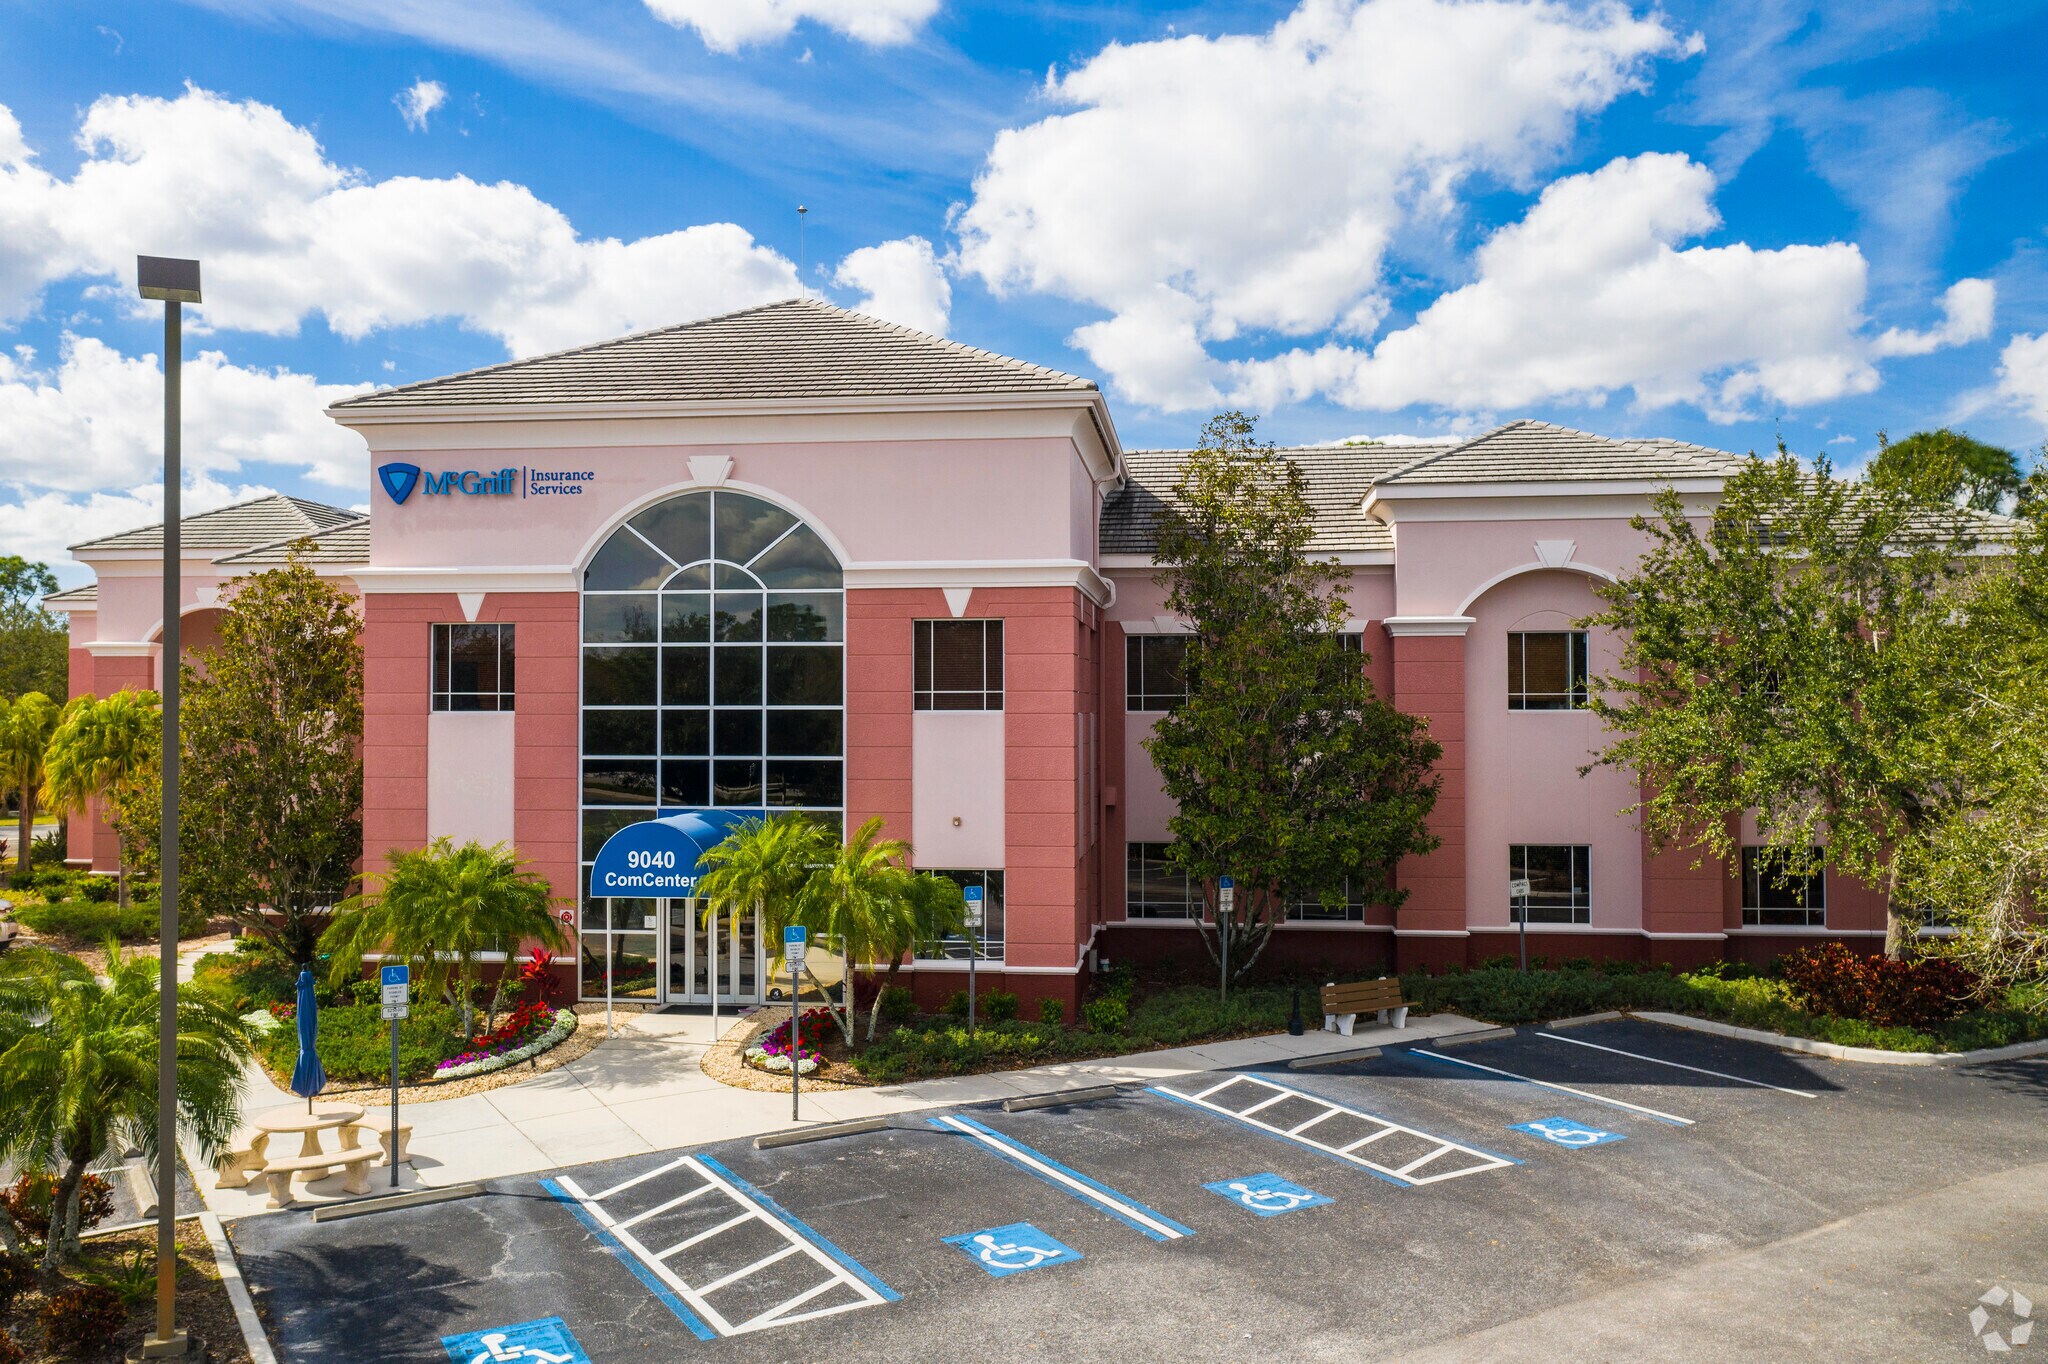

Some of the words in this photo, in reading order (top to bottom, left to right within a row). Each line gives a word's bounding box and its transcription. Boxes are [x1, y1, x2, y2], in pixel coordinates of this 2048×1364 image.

[422, 468, 517, 495] McGriff
[530, 469, 594, 481] Insurance
[530, 482, 583, 495] Services
[627, 850, 675, 869] 9040
[605, 872, 697, 888] ComCenter
